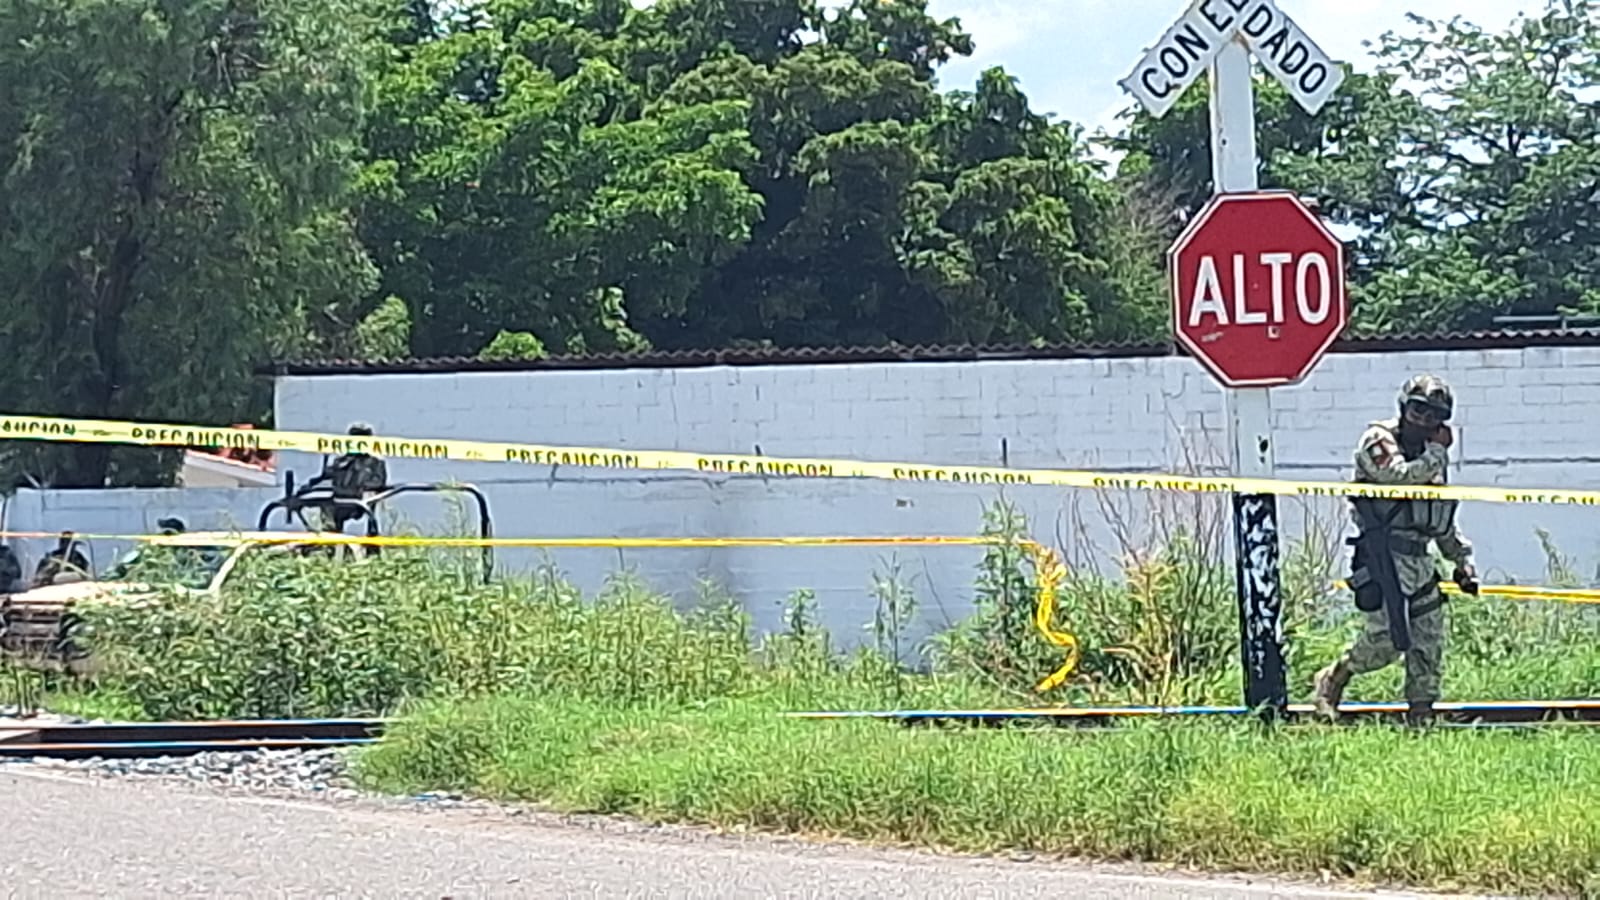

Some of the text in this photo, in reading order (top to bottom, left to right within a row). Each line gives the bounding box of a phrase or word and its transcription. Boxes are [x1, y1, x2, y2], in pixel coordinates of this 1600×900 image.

[1141, 23, 1210, 99] CON
[1243, 3, 1327, 94] DADO
[1188, 252, 1331, 327] ALTO
[131, 427, 260, 450] PRECAUCION
[317, 437, 448, 459] PRECAUCION
